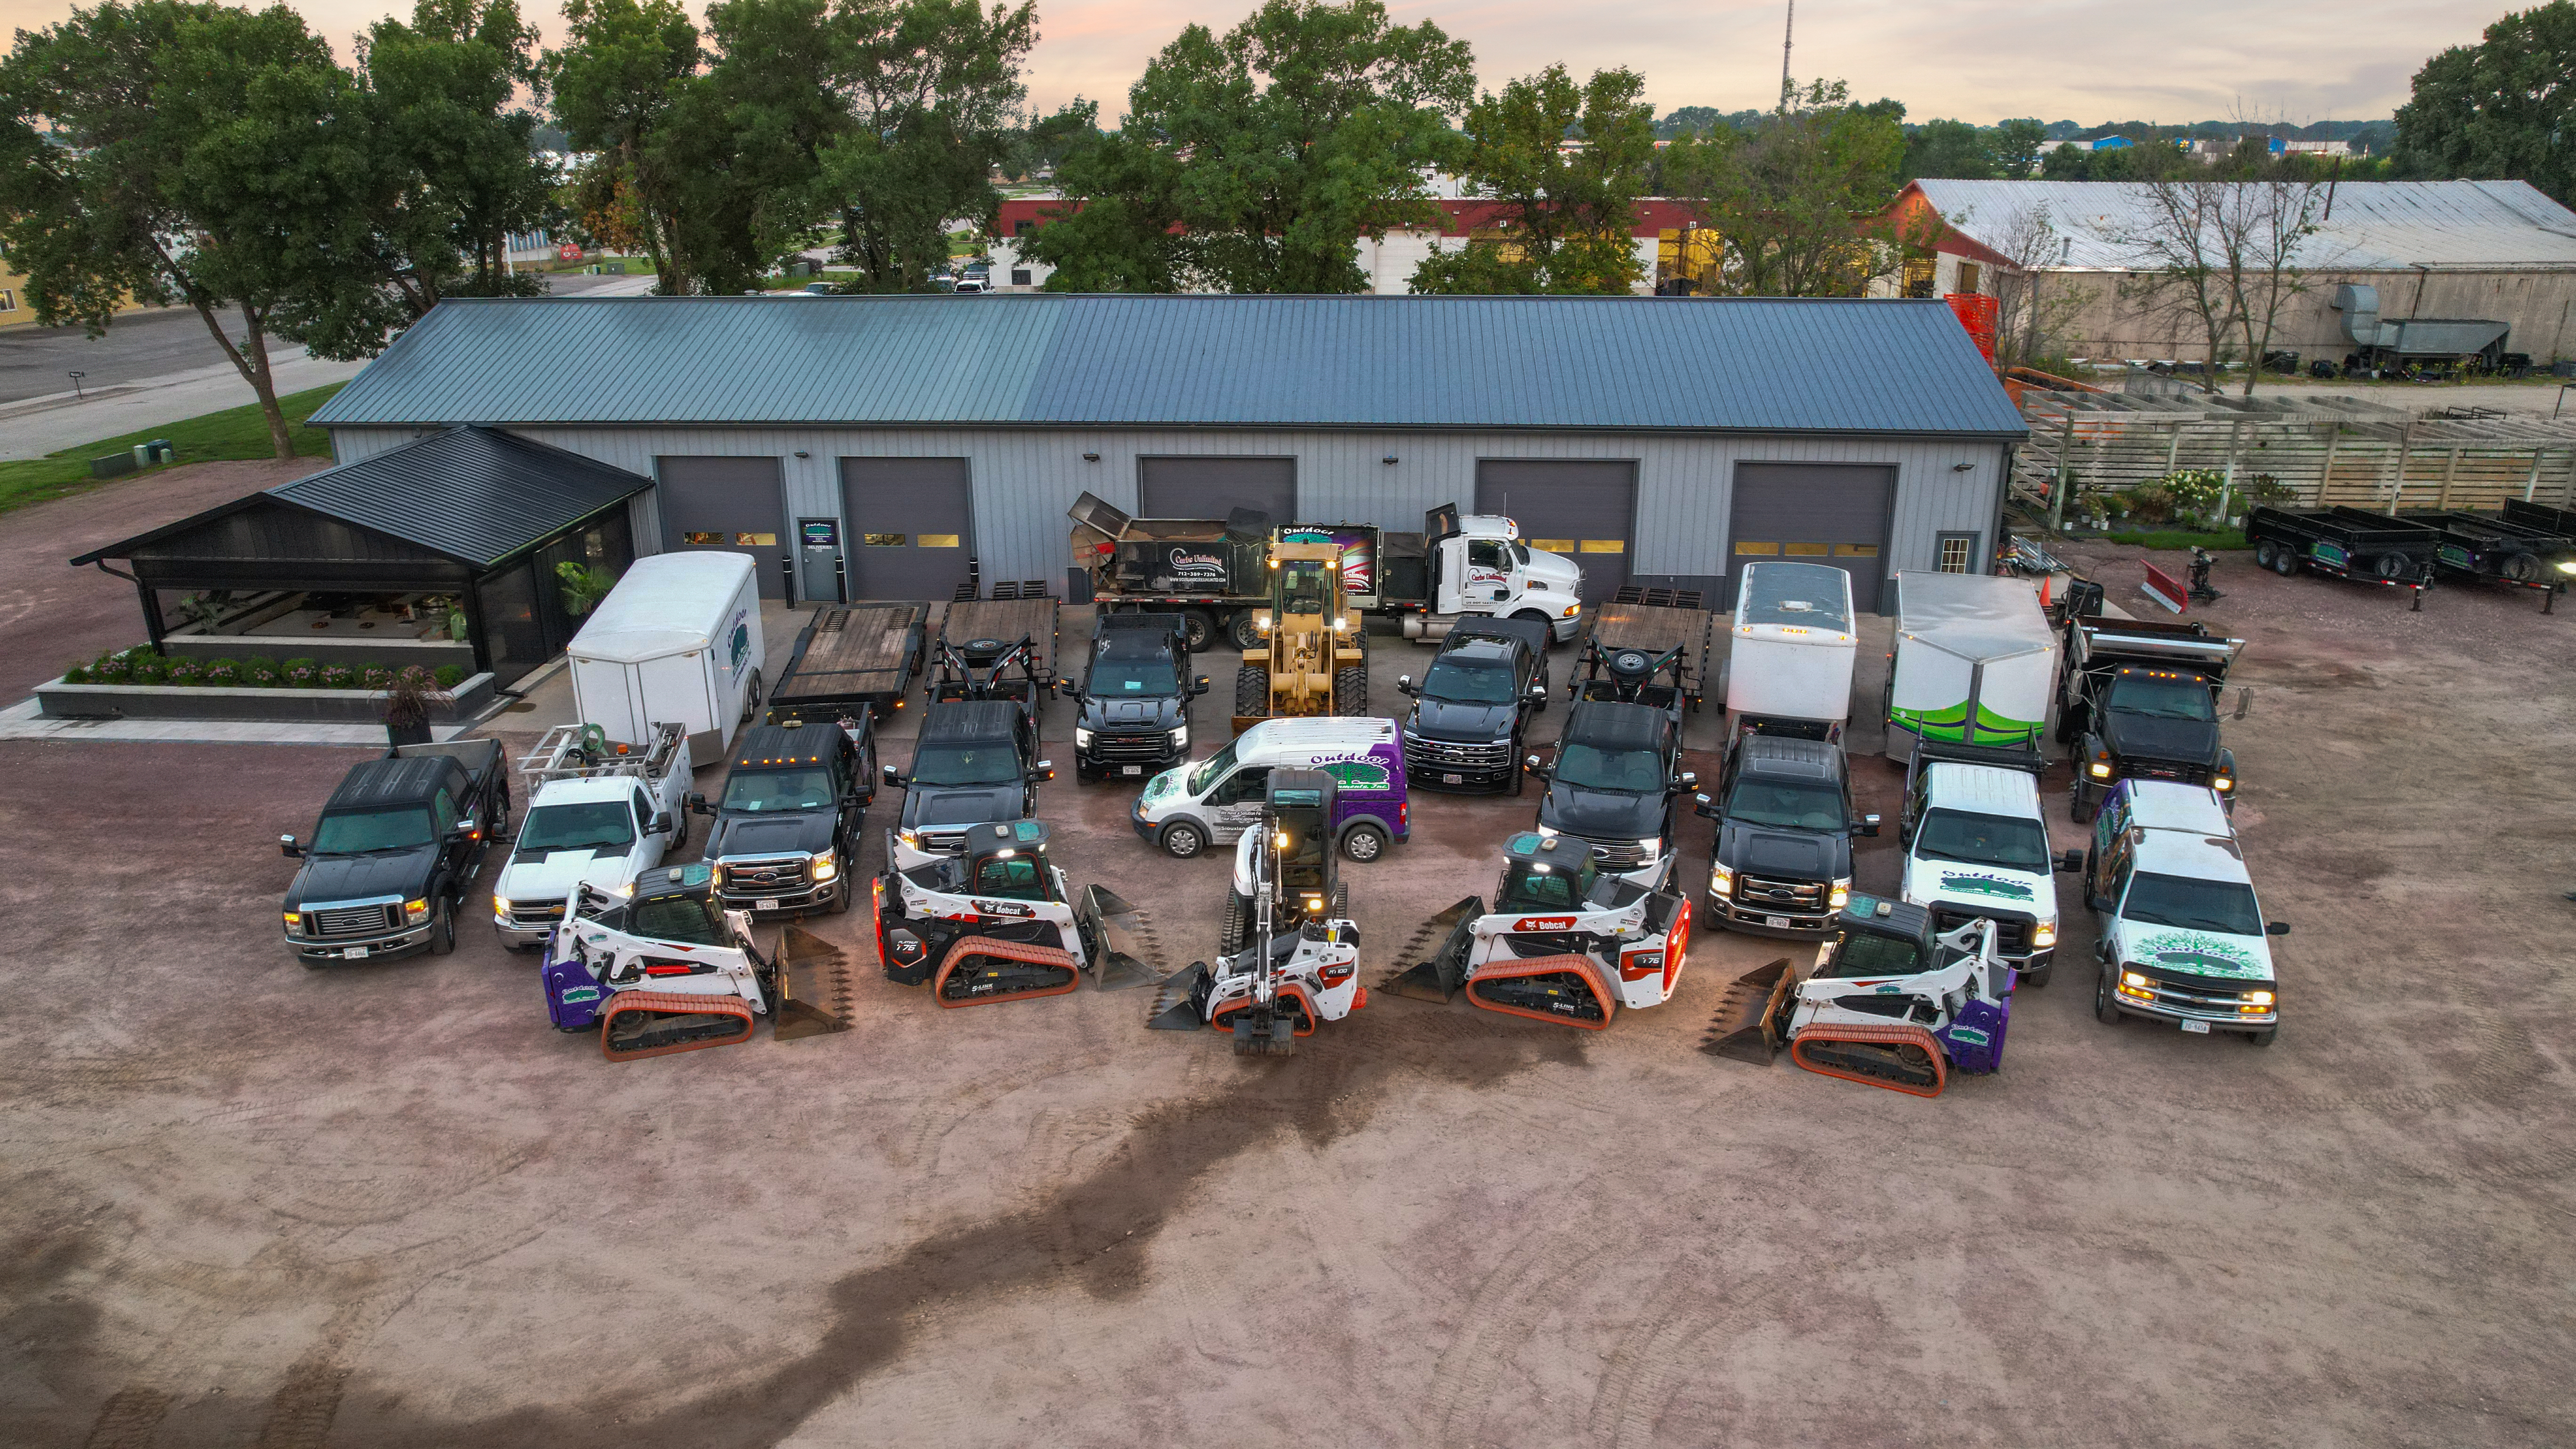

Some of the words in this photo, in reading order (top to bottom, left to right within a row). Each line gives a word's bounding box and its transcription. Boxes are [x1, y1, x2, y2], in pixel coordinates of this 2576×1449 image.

[1283, 526, 1334, 535] Outdoor
[1194, 554, 1222, 566] Unlimited
[1344, 572, 1369, 582] Unlimited
[728, 609, 747, 649] Outdoor
[1311, 753, 1390, 765] Outdoor
[1942, 870, 2033, 886] Outdoor
[996, 906, 1020, 915] Bobcat
[1539, 921, 1567, 930] Bobcat
[2156, 946, 2240, 960] Outdoor
[562, 985, 598, 994] Outdoor
[972, 983, 993, 992] 5-LINK
[1553, 1002, 1575, 1010] 5-LINK
[1951, 1024, 1990, 1036] Outdoor
